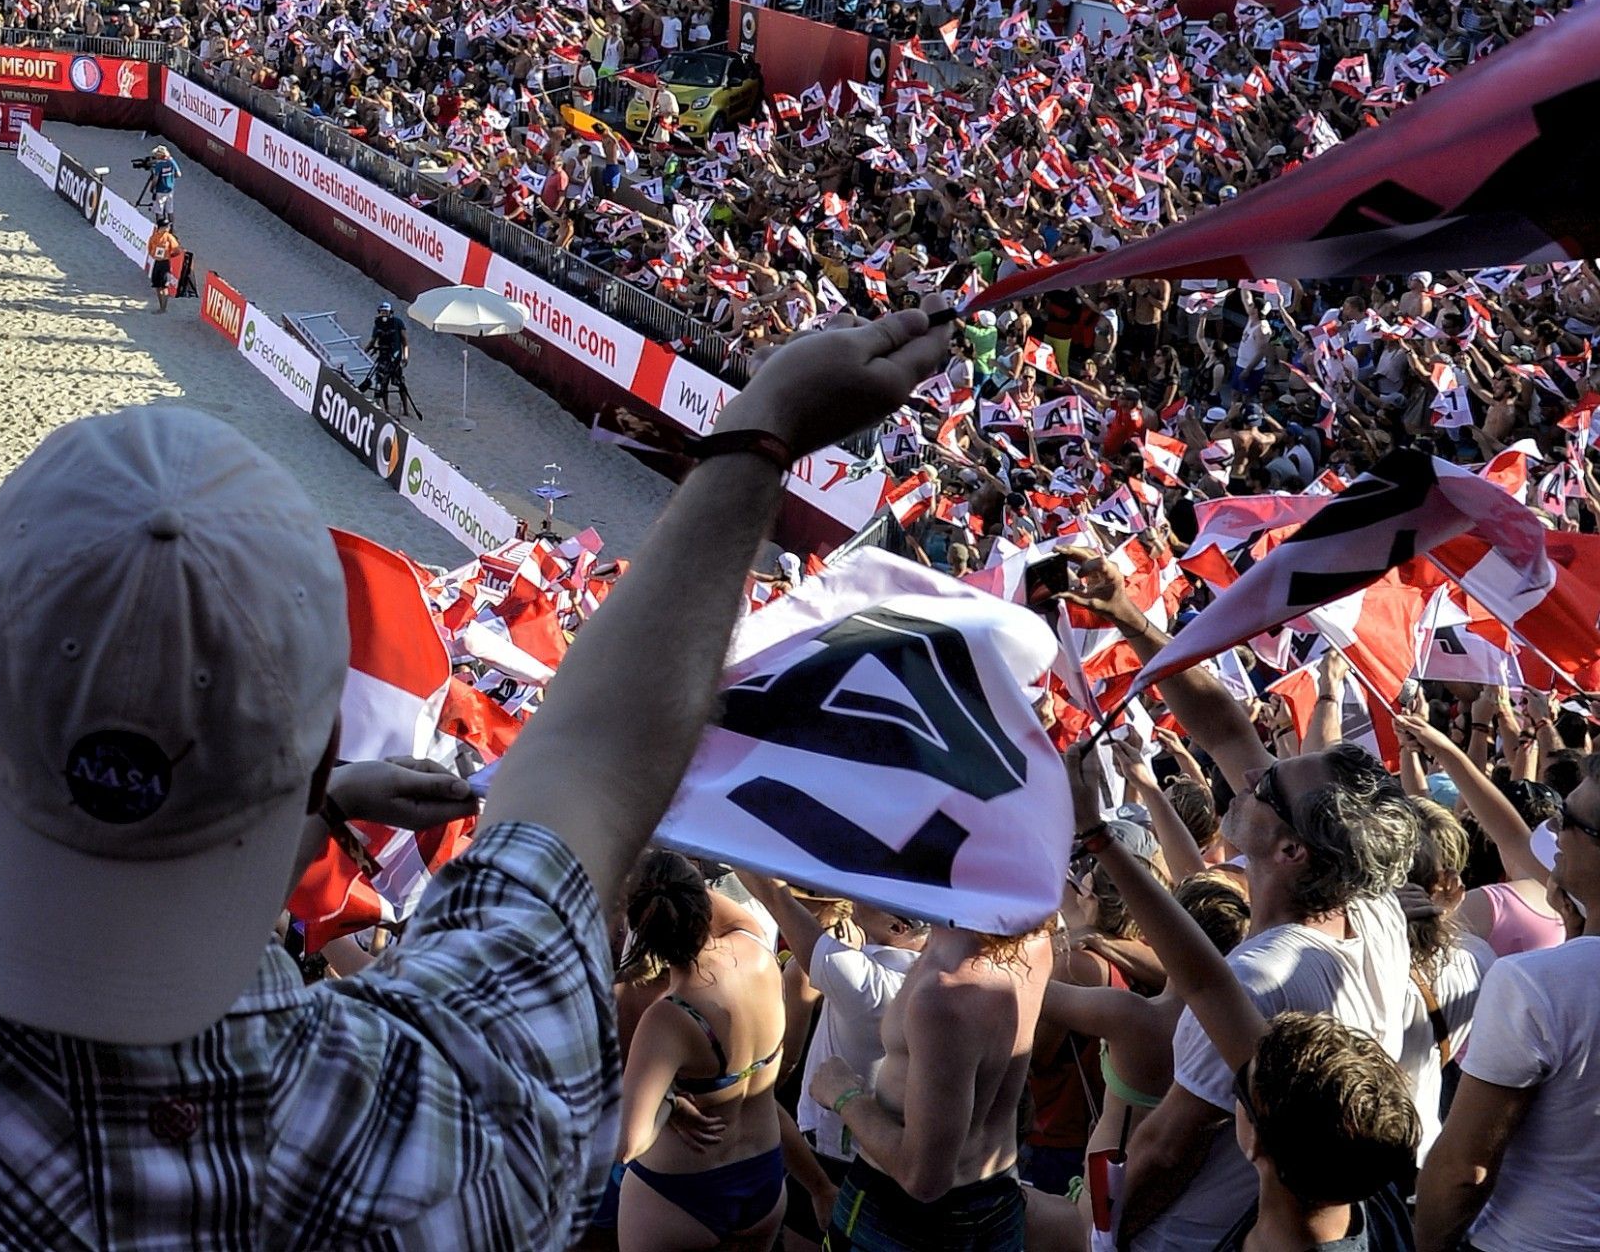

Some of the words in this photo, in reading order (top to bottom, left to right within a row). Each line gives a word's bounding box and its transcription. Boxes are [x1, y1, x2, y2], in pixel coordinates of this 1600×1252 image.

[1, 90, 30, 102] VIENNA
[57, 164, 86, 208] smart
[263, 133, 277, 168] Fly
[278, 144, 289, 167] to
[291, 148, 310, 181] 130
[312, 163, 378, 222] destinations
[380, 205, 445, 263] worldwide
[205, 283, 242, 344] VIENNA
[253, 333, 314, 400] checkrobin.com
[318, 383, 375, 458] smart
[1043, 401, 1071, 430] A1
[71, 756, 165, 796] NASA
